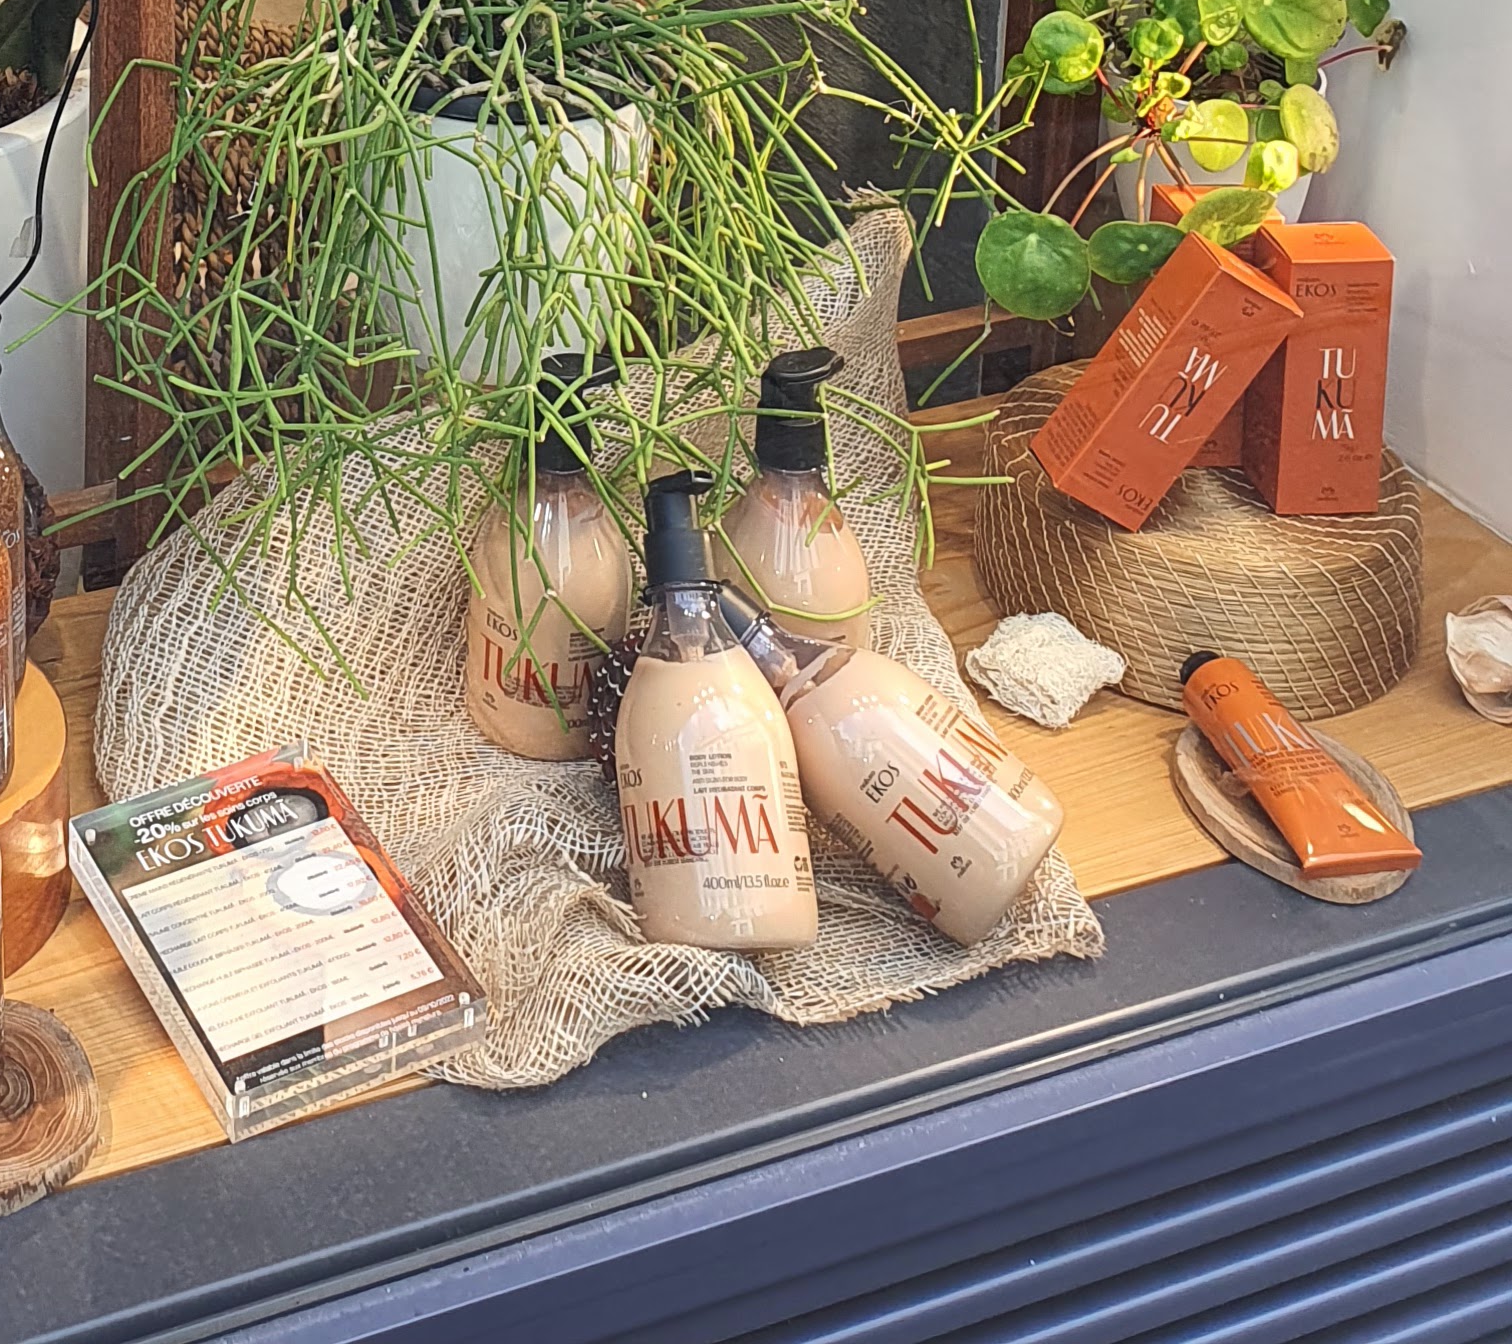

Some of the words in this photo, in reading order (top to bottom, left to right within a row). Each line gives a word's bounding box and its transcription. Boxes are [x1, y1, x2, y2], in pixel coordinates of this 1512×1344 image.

[1296, 282, 1337, 298] EKOS
[1319, 348, 1356, 379] TU
[1315, 378, 1356, 409] KU
[1139, 403, 1182, 444] TU
[1311, 409, 1354, 440] MÃ
[1117, 484, 1154, 511] EKOS
[486, 613, 518, 641] EKOS
[1203, 682, 1240, 711] EKOS
[865, 761, 901, 804] EKOS
[129, 806, 175, 829] OFFRE
[173, 775, 263, 814] DÉCOUVERTE
[134, 820, 181, 846] -20%
[182, 817, 199, 831] sur
[199, 810, 216, 825] les
[217, 802, 245, 818] soins
[245, 791, 278, 808] corps
[623, 794, 779, 865] TUKUMÃ
[135, 831, 206, 872] EKOS
[202, 798, 299, 848] TUKUMÃ
